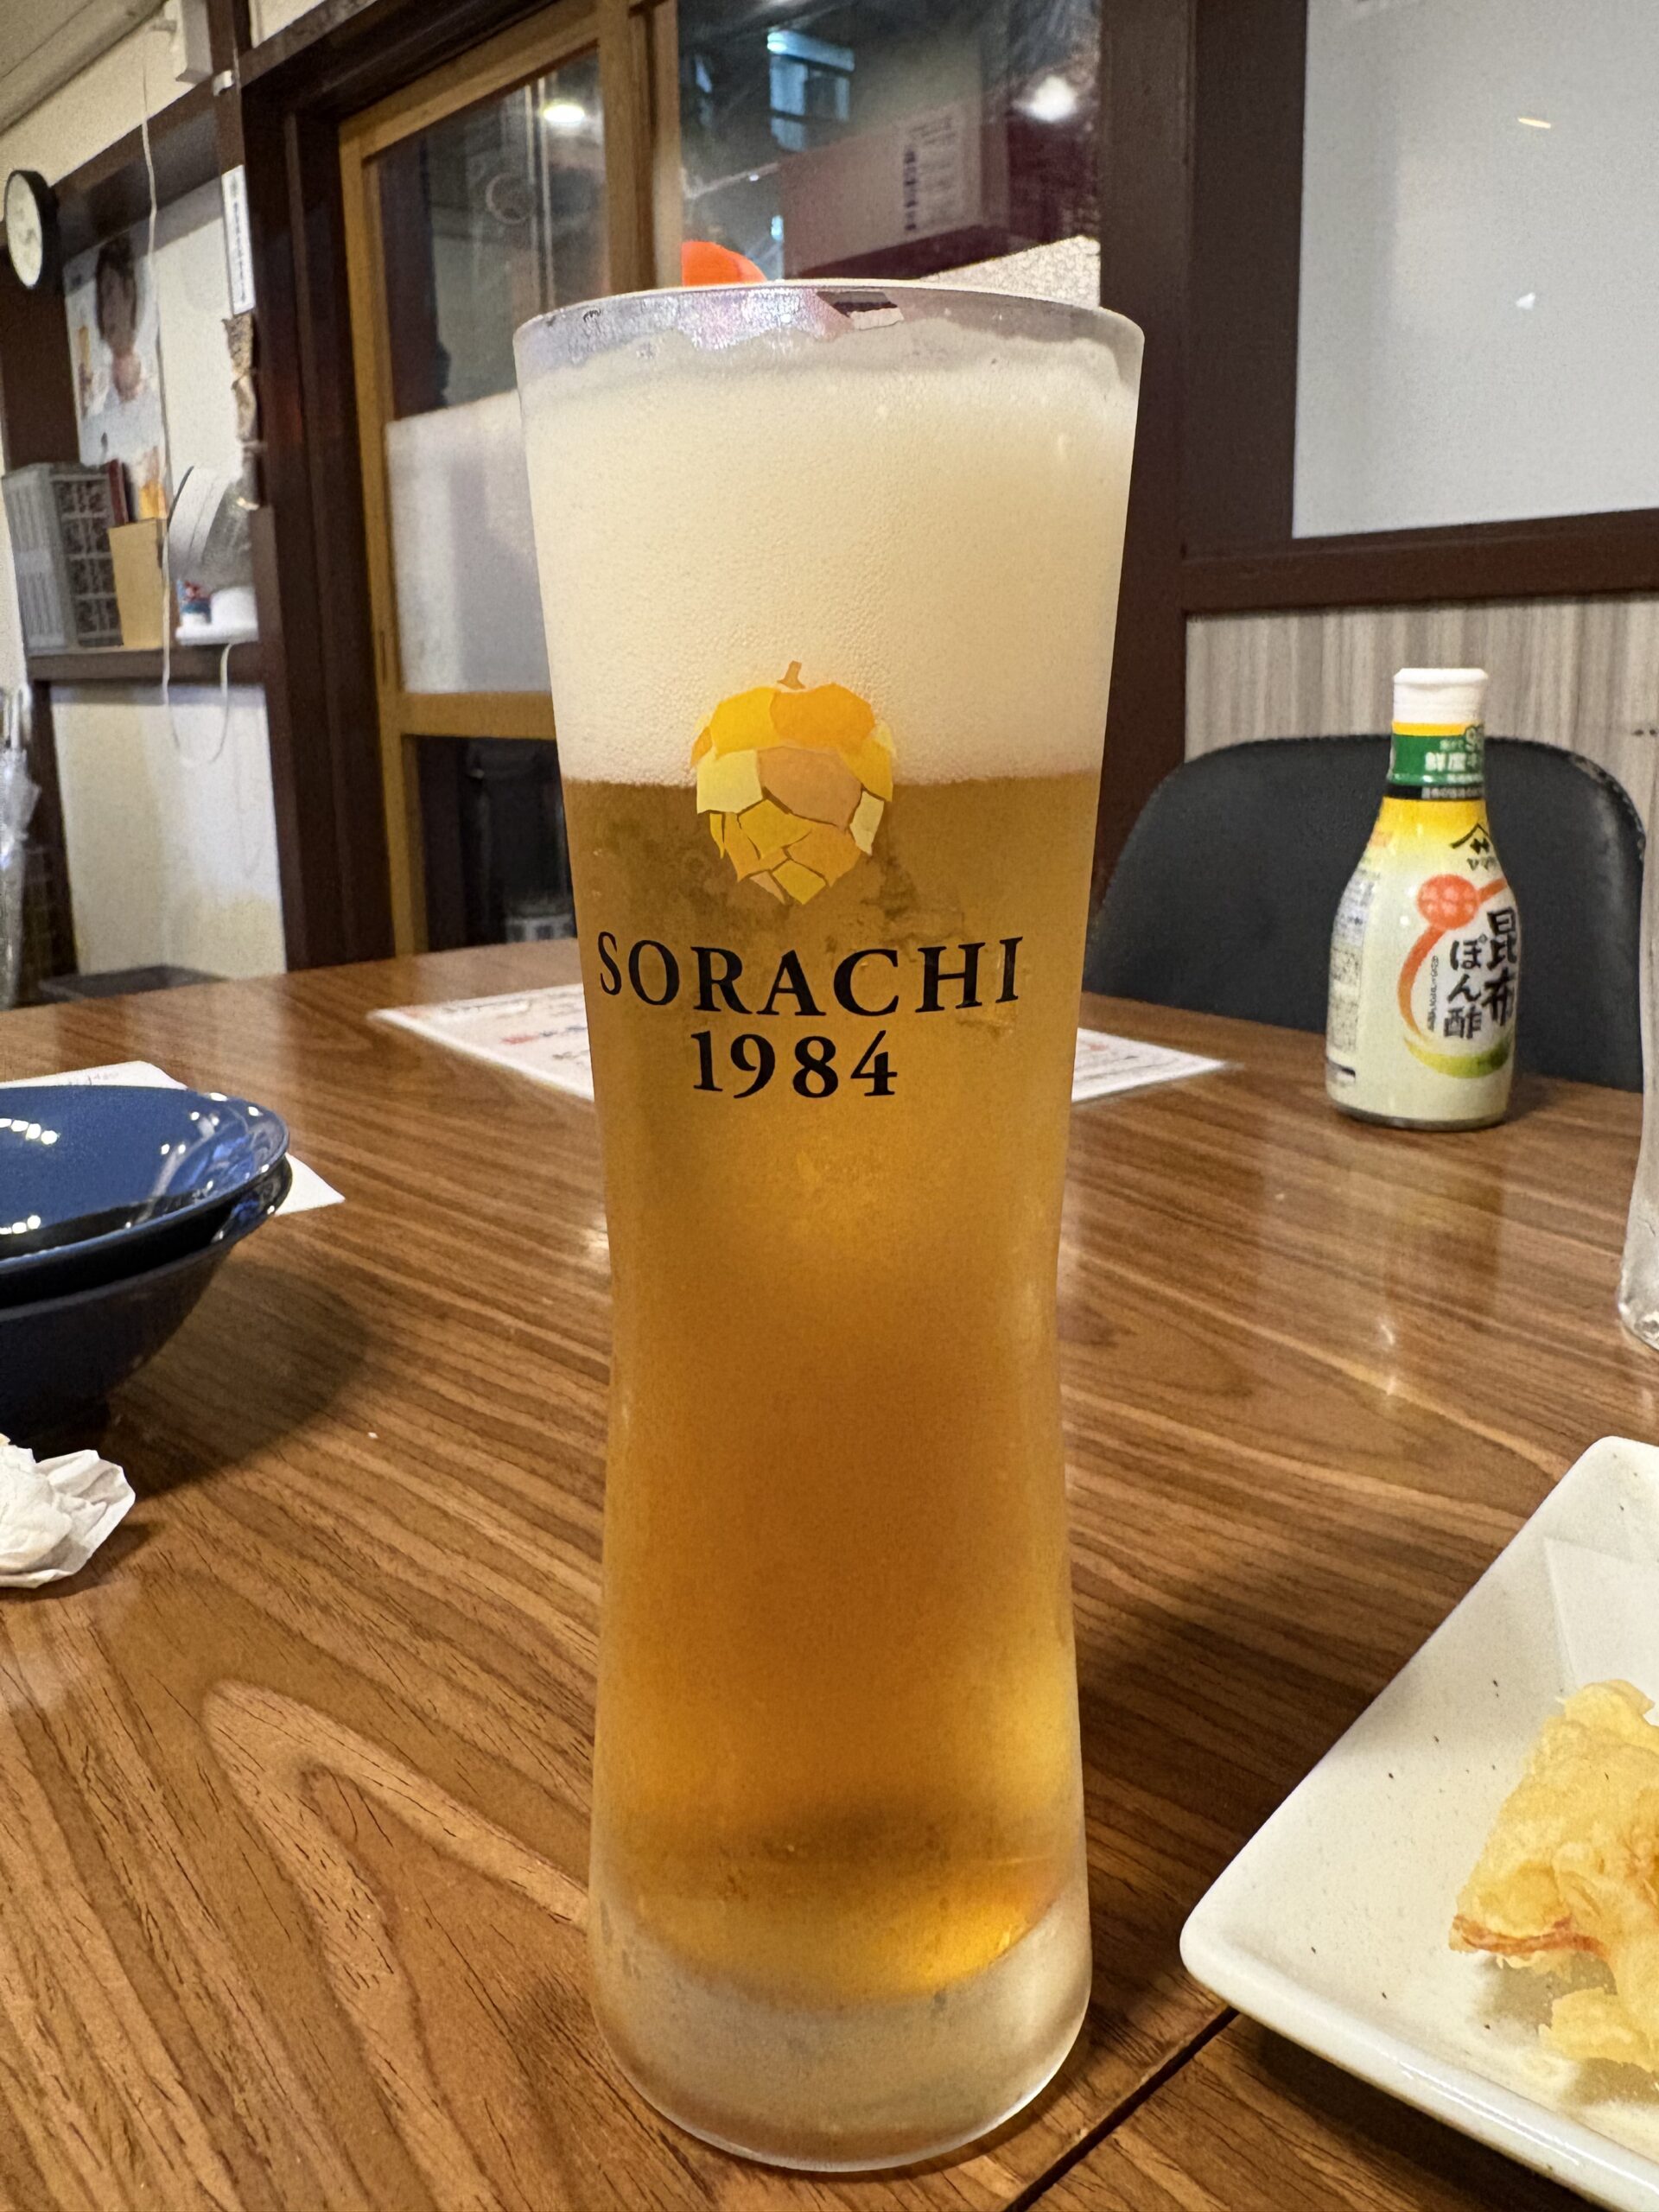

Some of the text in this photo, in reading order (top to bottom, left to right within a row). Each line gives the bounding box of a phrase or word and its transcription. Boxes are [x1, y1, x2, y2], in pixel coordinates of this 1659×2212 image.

[597, 931, 1023, 1018] SORACHI
[1444, 933, 1488, 1039] ぽん酢
[690, 1030, 899, 1099] 1984
